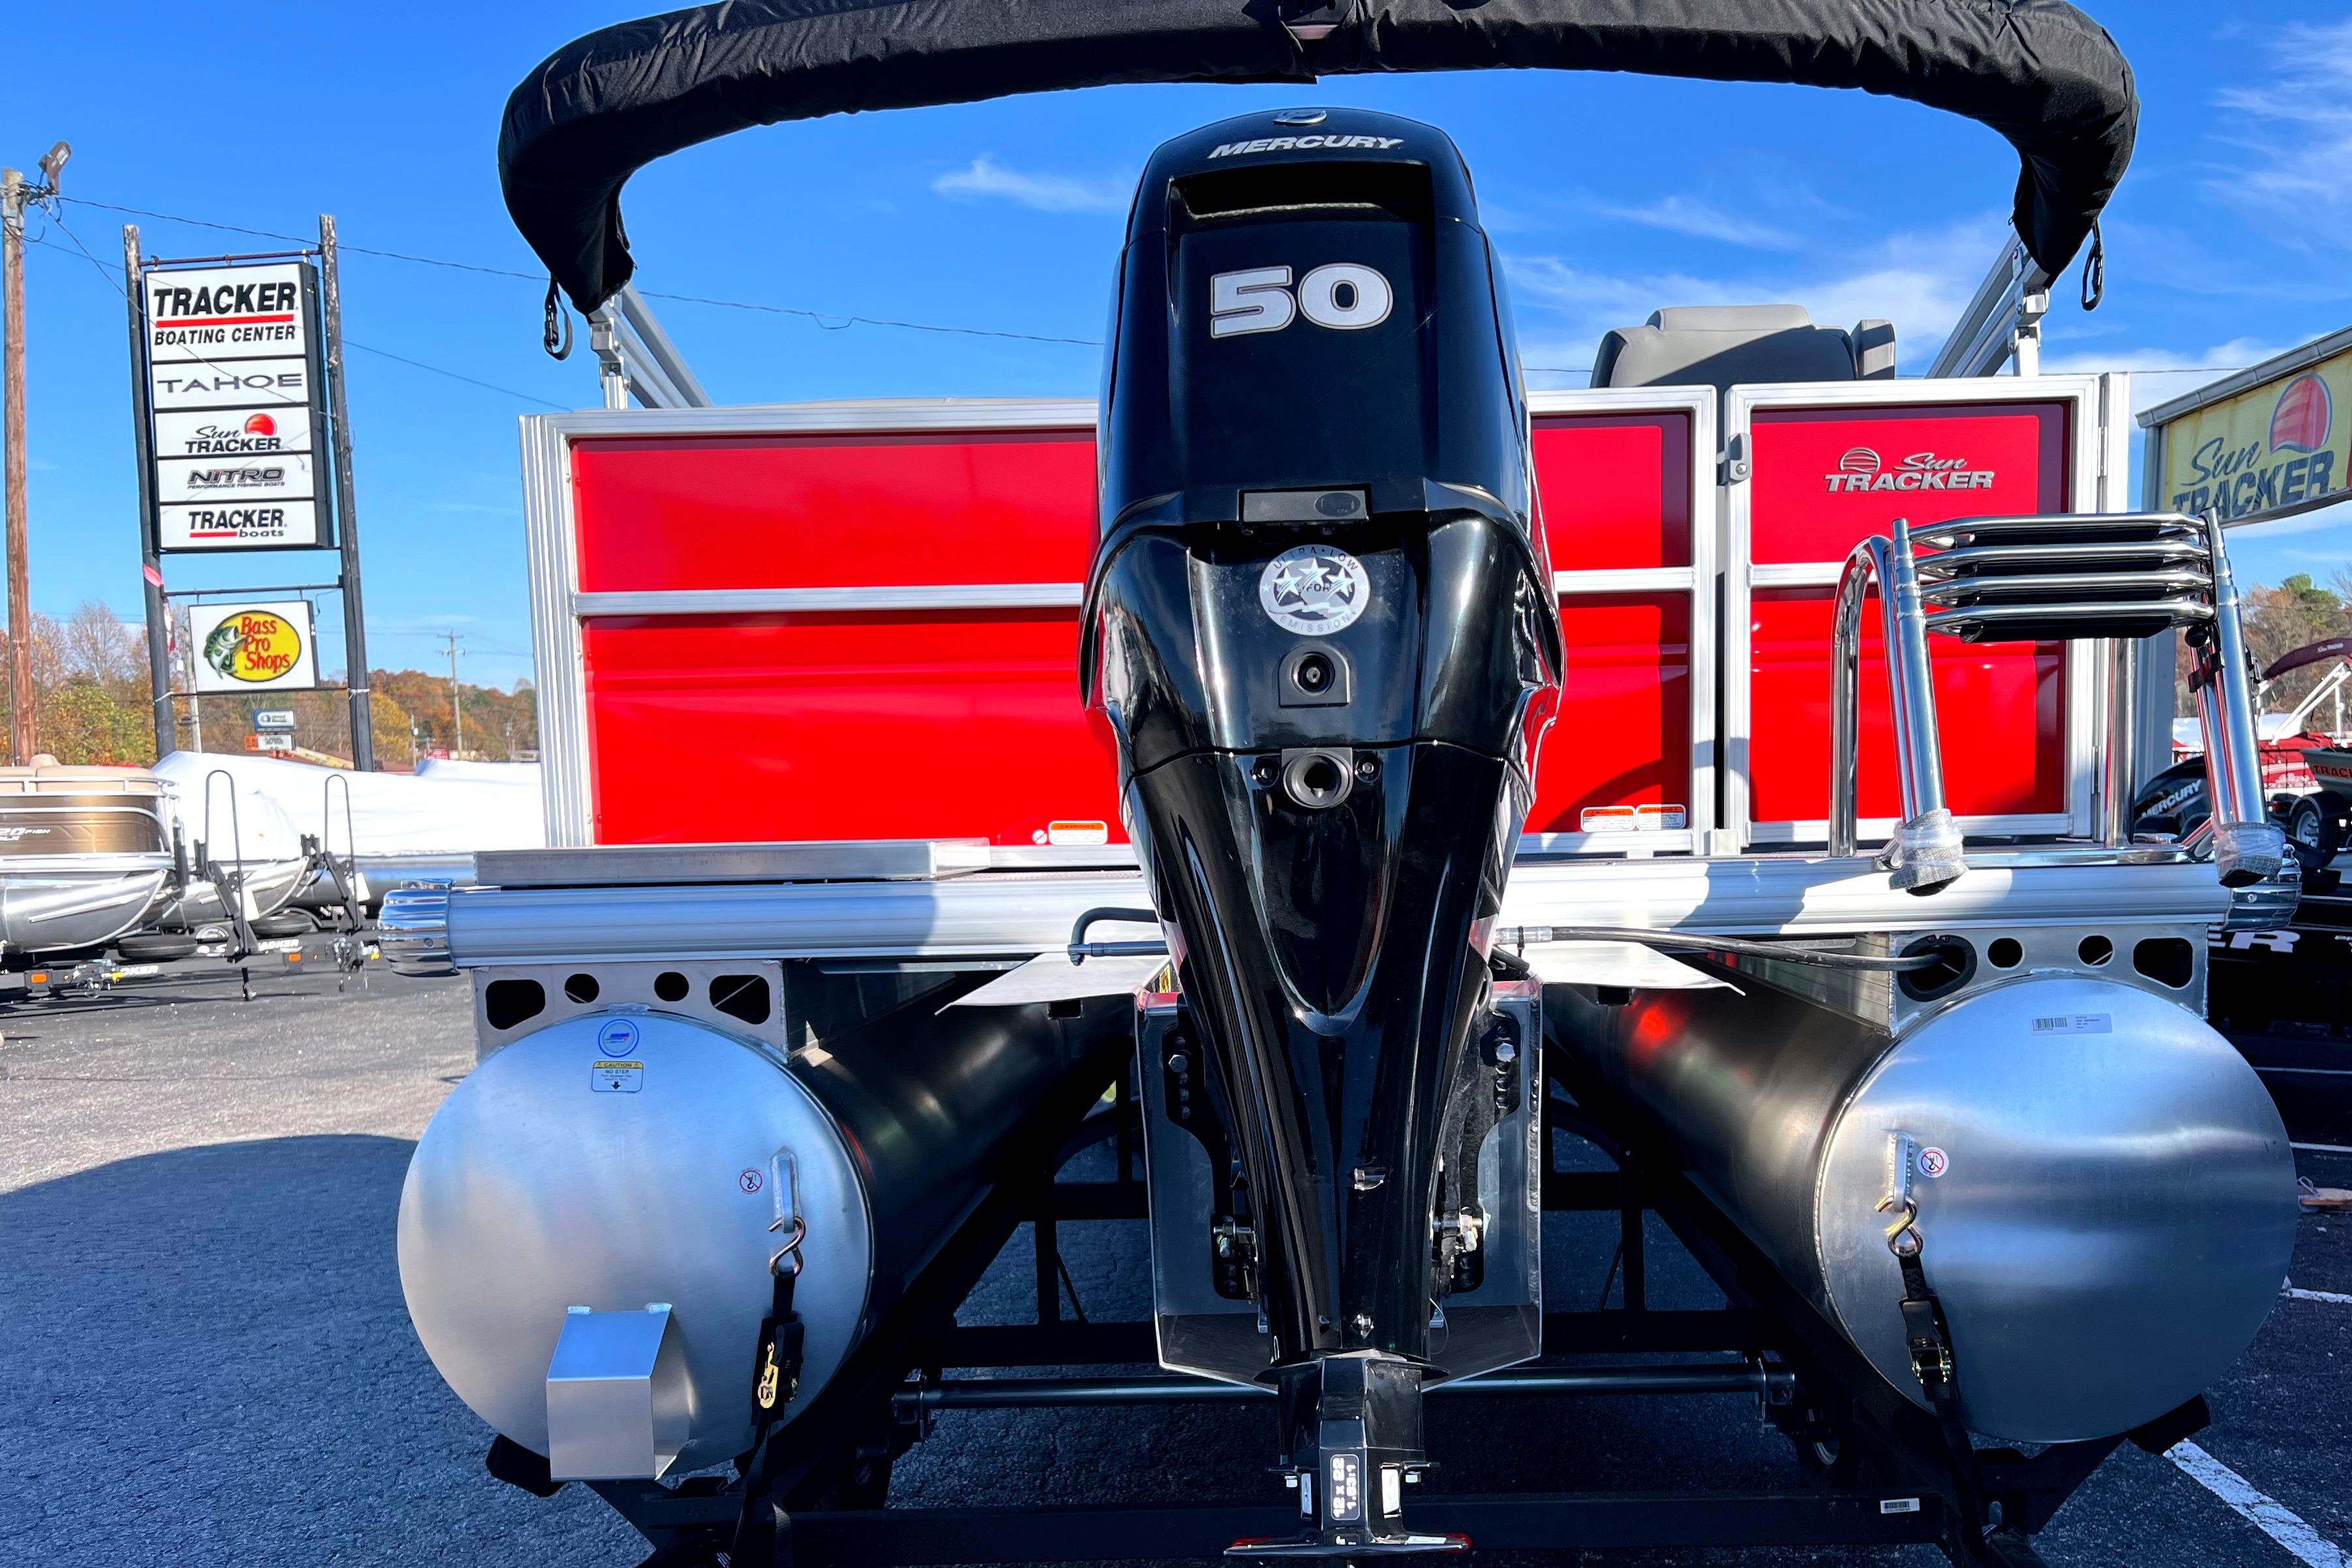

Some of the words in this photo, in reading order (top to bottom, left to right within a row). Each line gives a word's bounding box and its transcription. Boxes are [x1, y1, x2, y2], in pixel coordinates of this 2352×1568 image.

[1207, 134, 1404, 159] MERCURY
[154, 282, 297, 316] TRACKER
[1211, 262, 1393, 339] 50
[155, 327, 225, 346] BOATING
[232, 324, 295, 342] CENTER
[157, 373, 303, 393] TAHOE
[193, 425, 241, 440] Sun
[185, 437, 281, 454] TRACKER
[1893, 452, 1967, 471] Sun
[2181, 437, 2262, 486] Sun
[1823, 470, 1995, 493] TRACKER
[2173, 450, 2334, 519] TRACKER
[188, 508, 284, 530] TRACKER
[239, 529, 284, 537] boats
[1273, 546, 1317, 569] ULTRA
[1329, 549, 1358, 571] LOW
[240, 616, 277, 635] Bass
[1280, 614, 1351, 633] EMISSION
[243, 635, 271, 652] Pro
[245, 651, 291, 674] Shops
